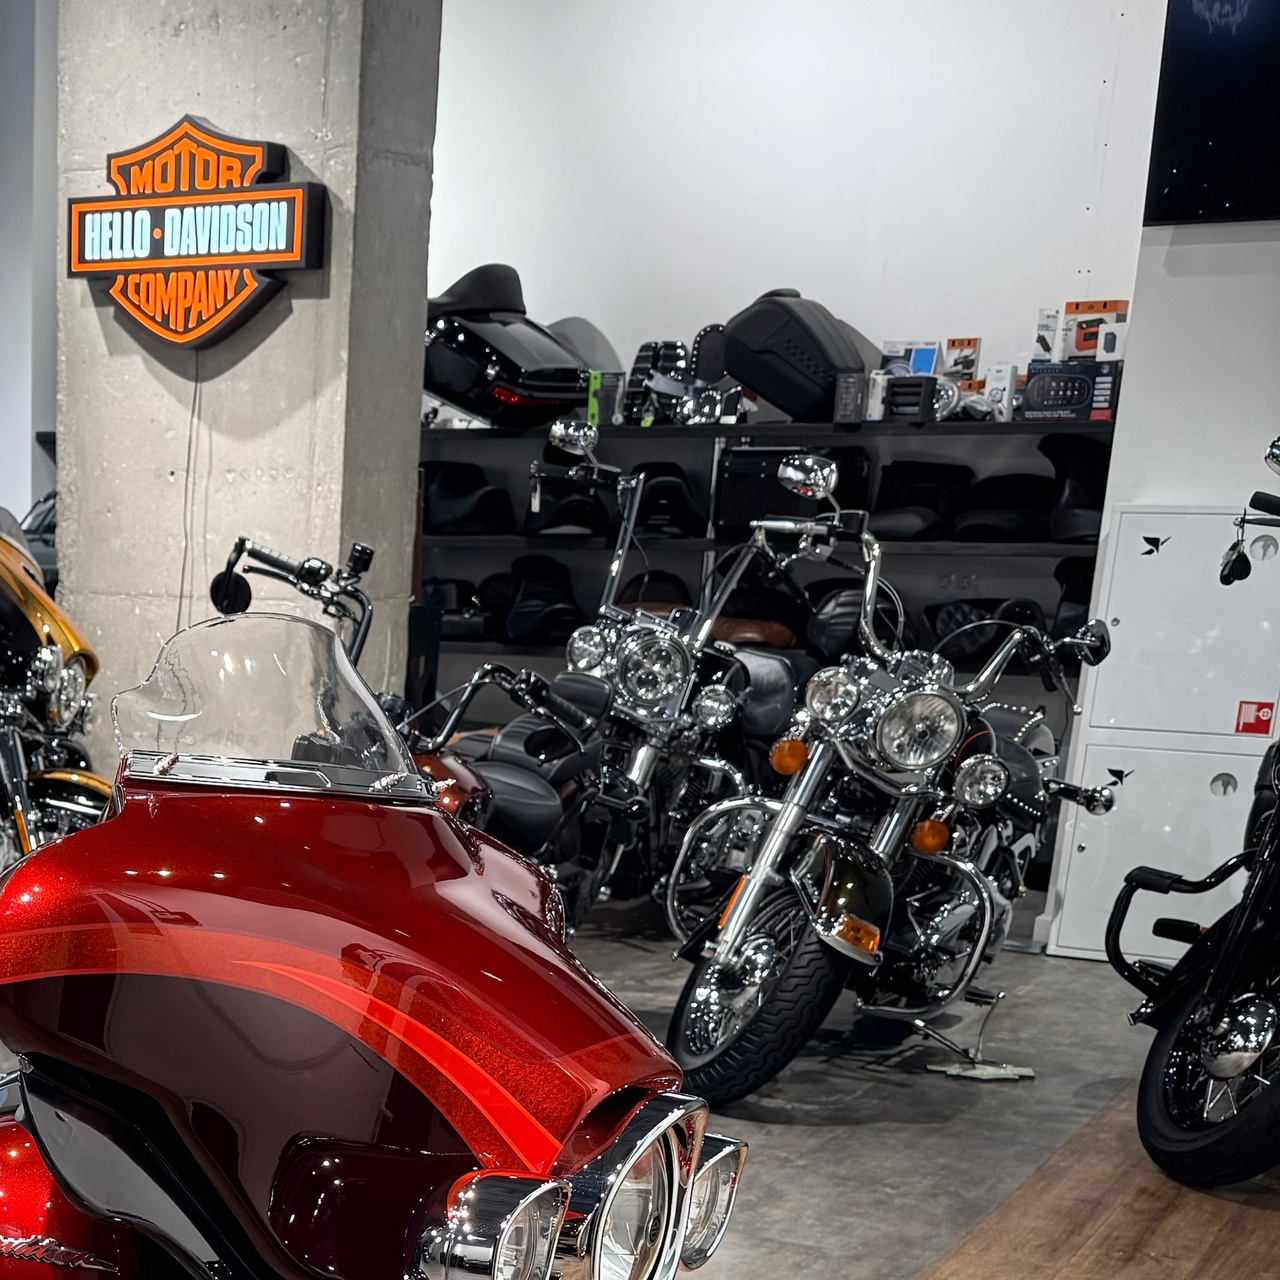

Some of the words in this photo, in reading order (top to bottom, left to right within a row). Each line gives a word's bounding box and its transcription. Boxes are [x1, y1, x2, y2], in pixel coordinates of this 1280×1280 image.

[130, 137, 242, 195] MOTOR
[85, 209, 151, 260] HELLO
[164, 201, 288, 256] DAVIDSON
[127, 268, 241, 332] COMPANY
